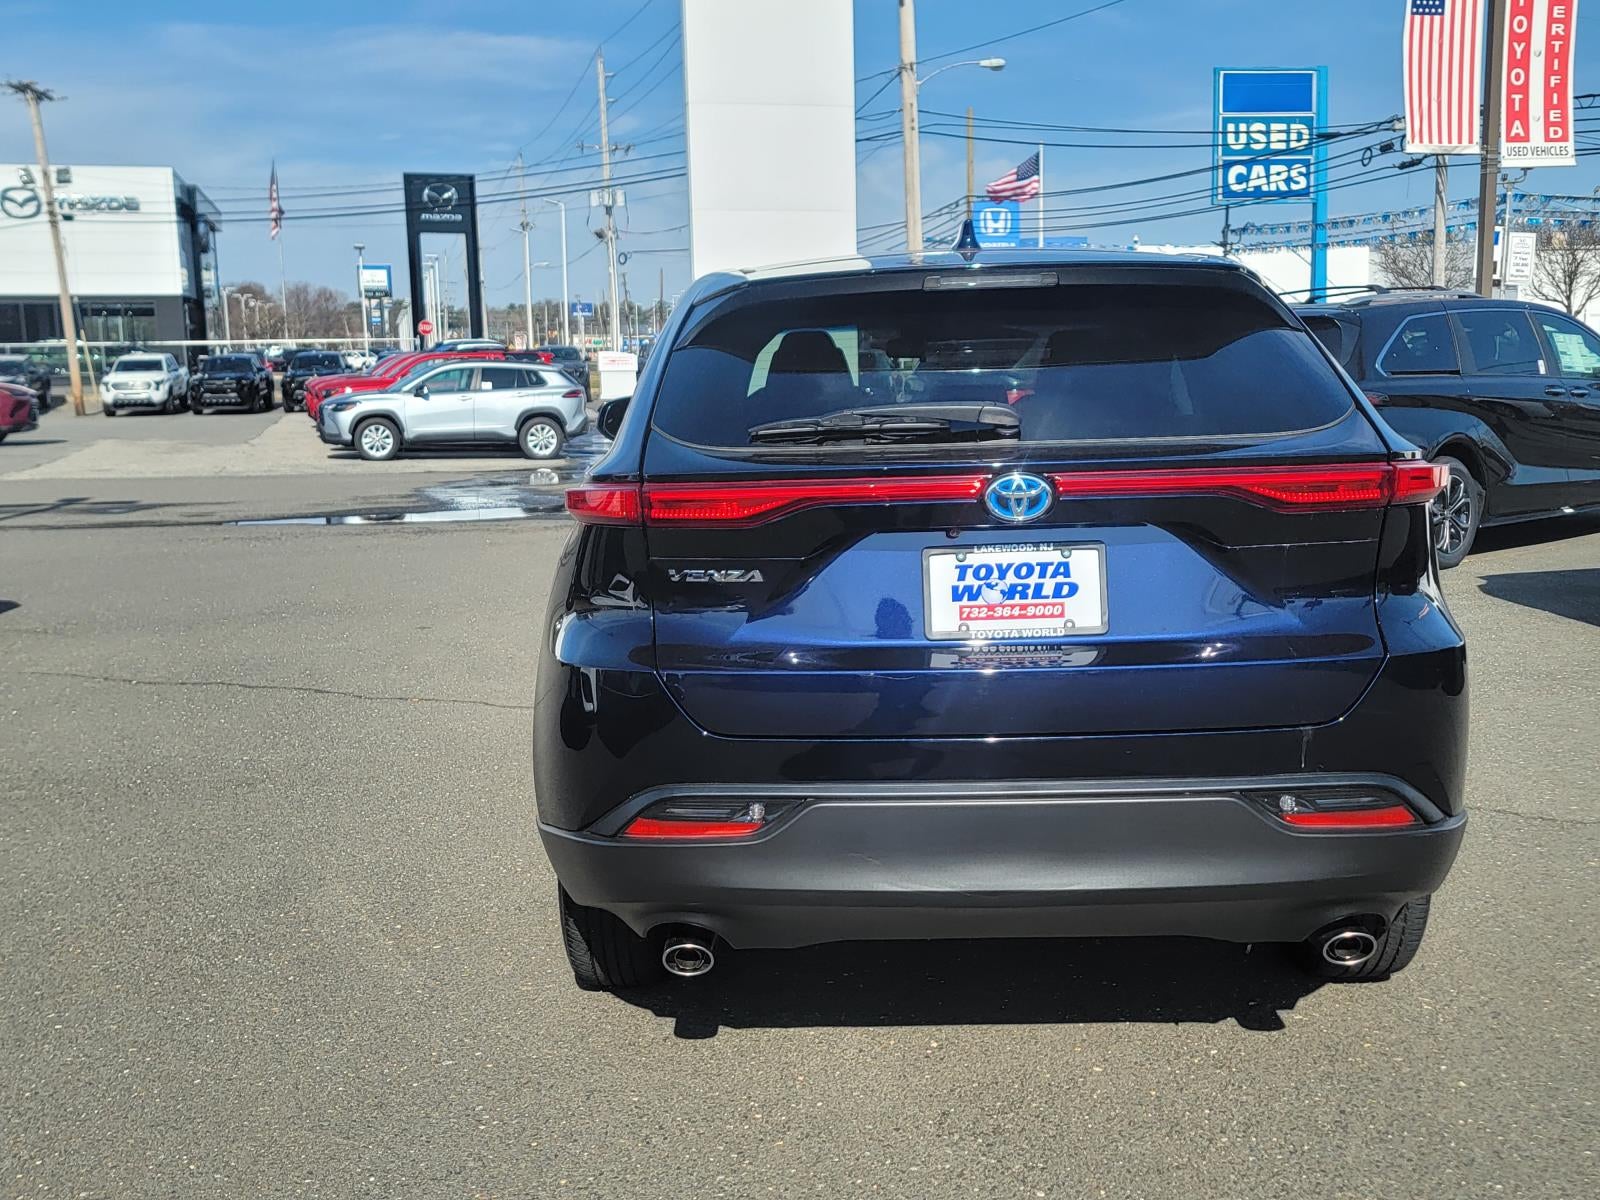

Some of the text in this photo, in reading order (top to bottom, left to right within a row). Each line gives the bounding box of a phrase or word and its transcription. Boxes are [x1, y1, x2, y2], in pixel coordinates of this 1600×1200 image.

[1226, 122, 1310, 150] USED
[1506, 145, 1569, 157] USED VEHICLES
[1227, 164, 1308, 192] CARS
[1039, 543, 1054, 552] NJ
[668, 569, 764, 582] VENZA
[954, 561, 1071, 582] TOYOTA
[969, 627, 1066, 639] TOYOTA WORLD
